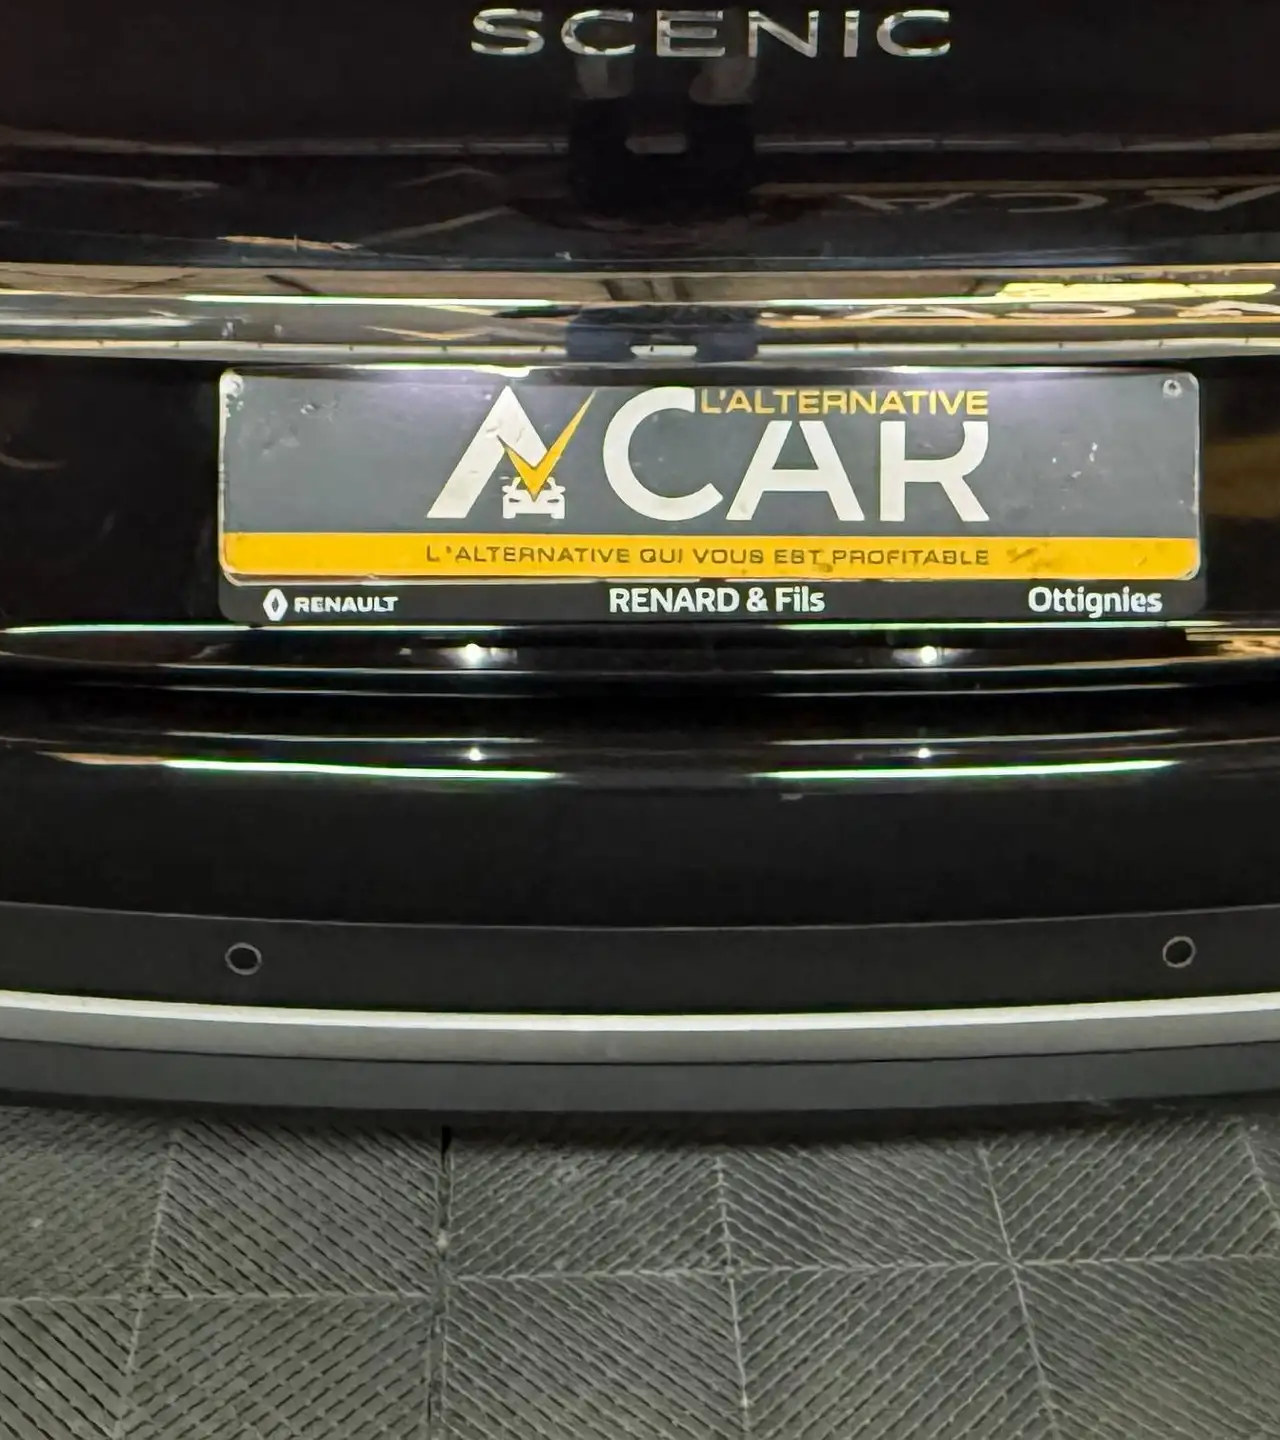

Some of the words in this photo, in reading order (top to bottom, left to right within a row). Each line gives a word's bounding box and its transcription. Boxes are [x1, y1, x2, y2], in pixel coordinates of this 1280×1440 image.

[470, 8, 952, 58] SCENIC
[701, 389, 989, 415] L'ALTERNATIVE
[426, 544, 630, 564] L'ALTERNATIVE
[639, 547, 683, 564] QUI
[692, 547, 765, 564] VOUS
[774, 548, 821, 565] EST
[832, 548, 990, 566] PROFITABLE
[293, 596, 399, 613] RENAULT
[609, 587, 740, 613] RENARD
[745, 587, 769, 613] &
[775, 586, 826, 613] Fils
[1027, 585, 1163, 619] Ottignies
